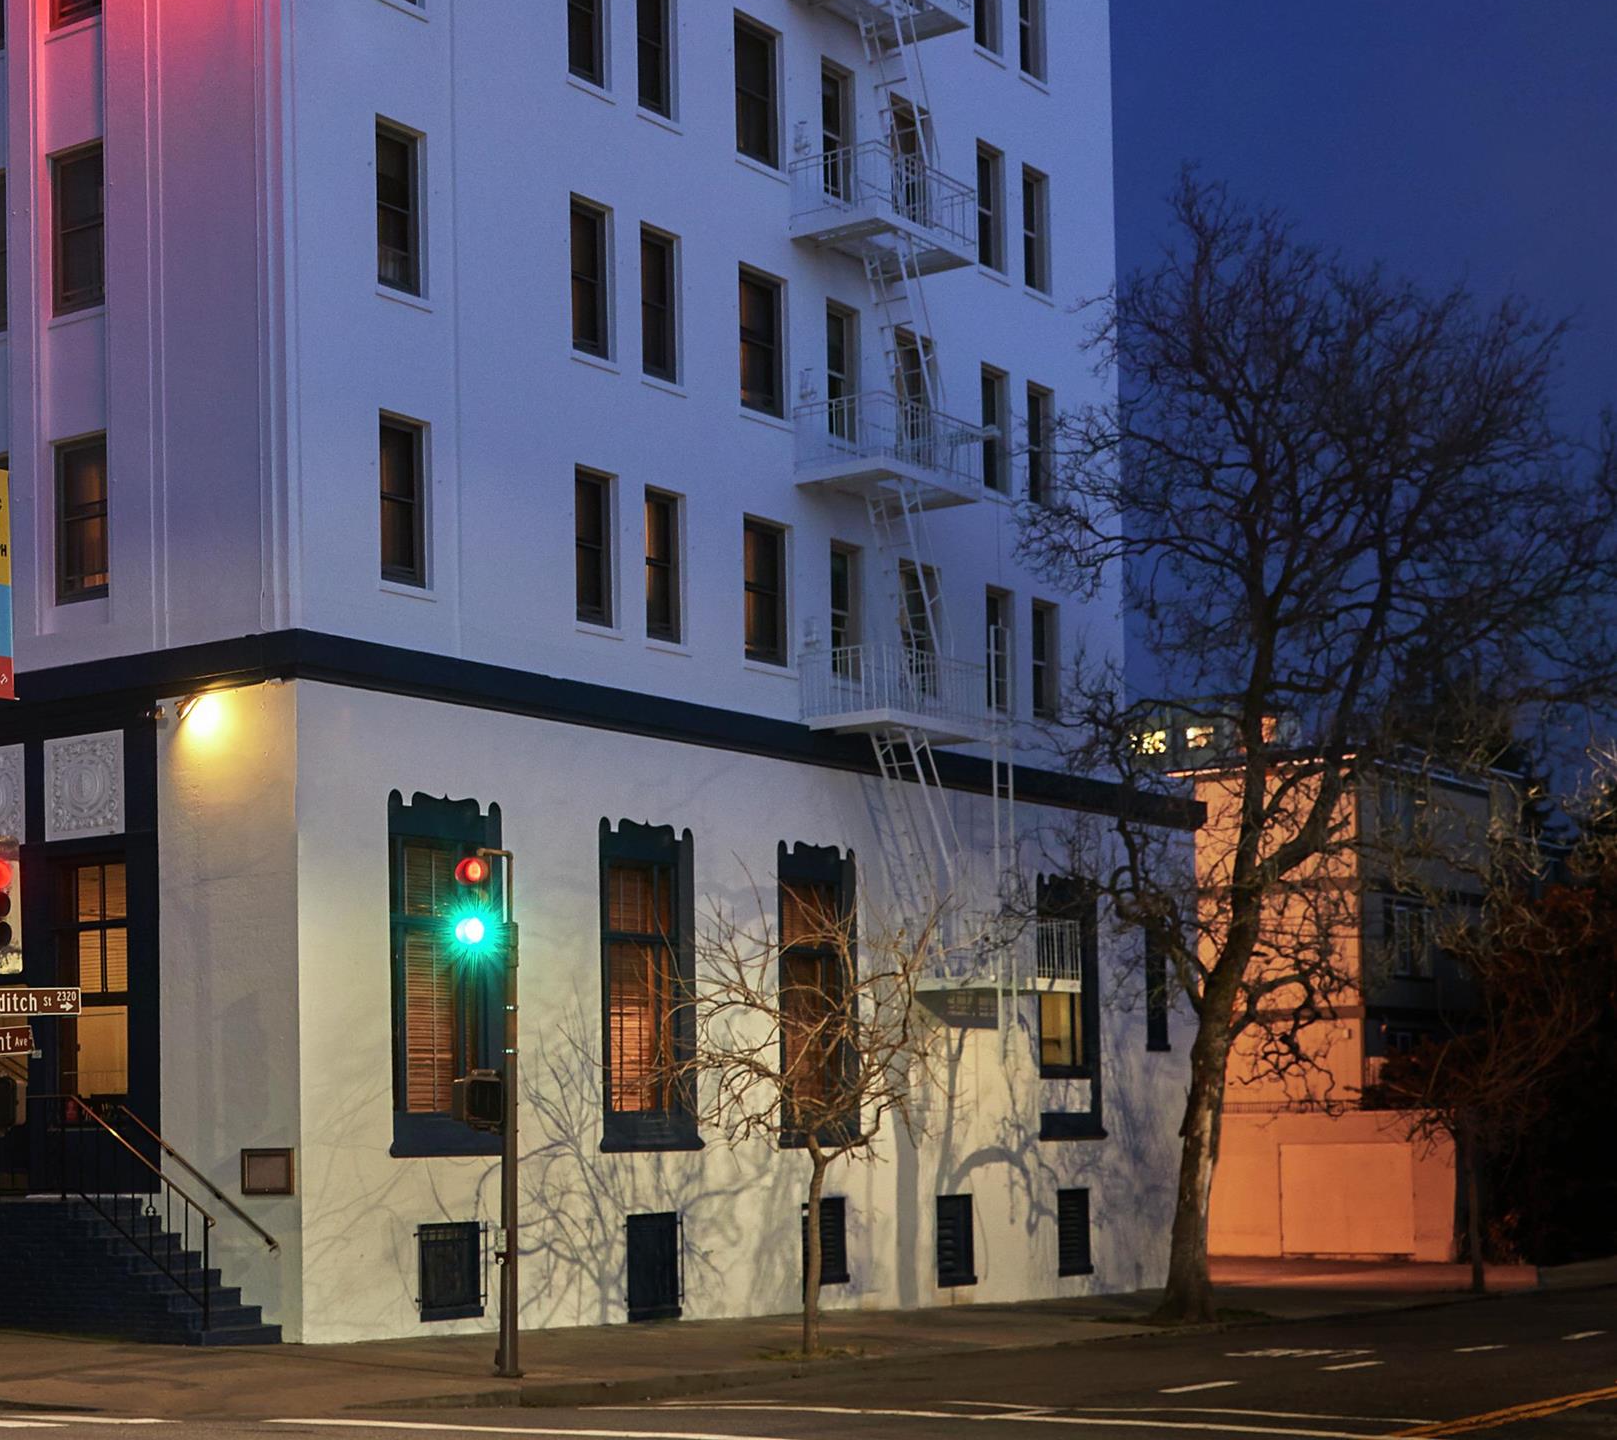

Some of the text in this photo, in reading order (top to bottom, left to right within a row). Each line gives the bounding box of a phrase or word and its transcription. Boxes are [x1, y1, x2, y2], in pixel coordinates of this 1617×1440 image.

[43, 997, 52, 1007] St
[56, 991, 77, 1002] 2320
[15, 1037, 28, 1047] Ave
